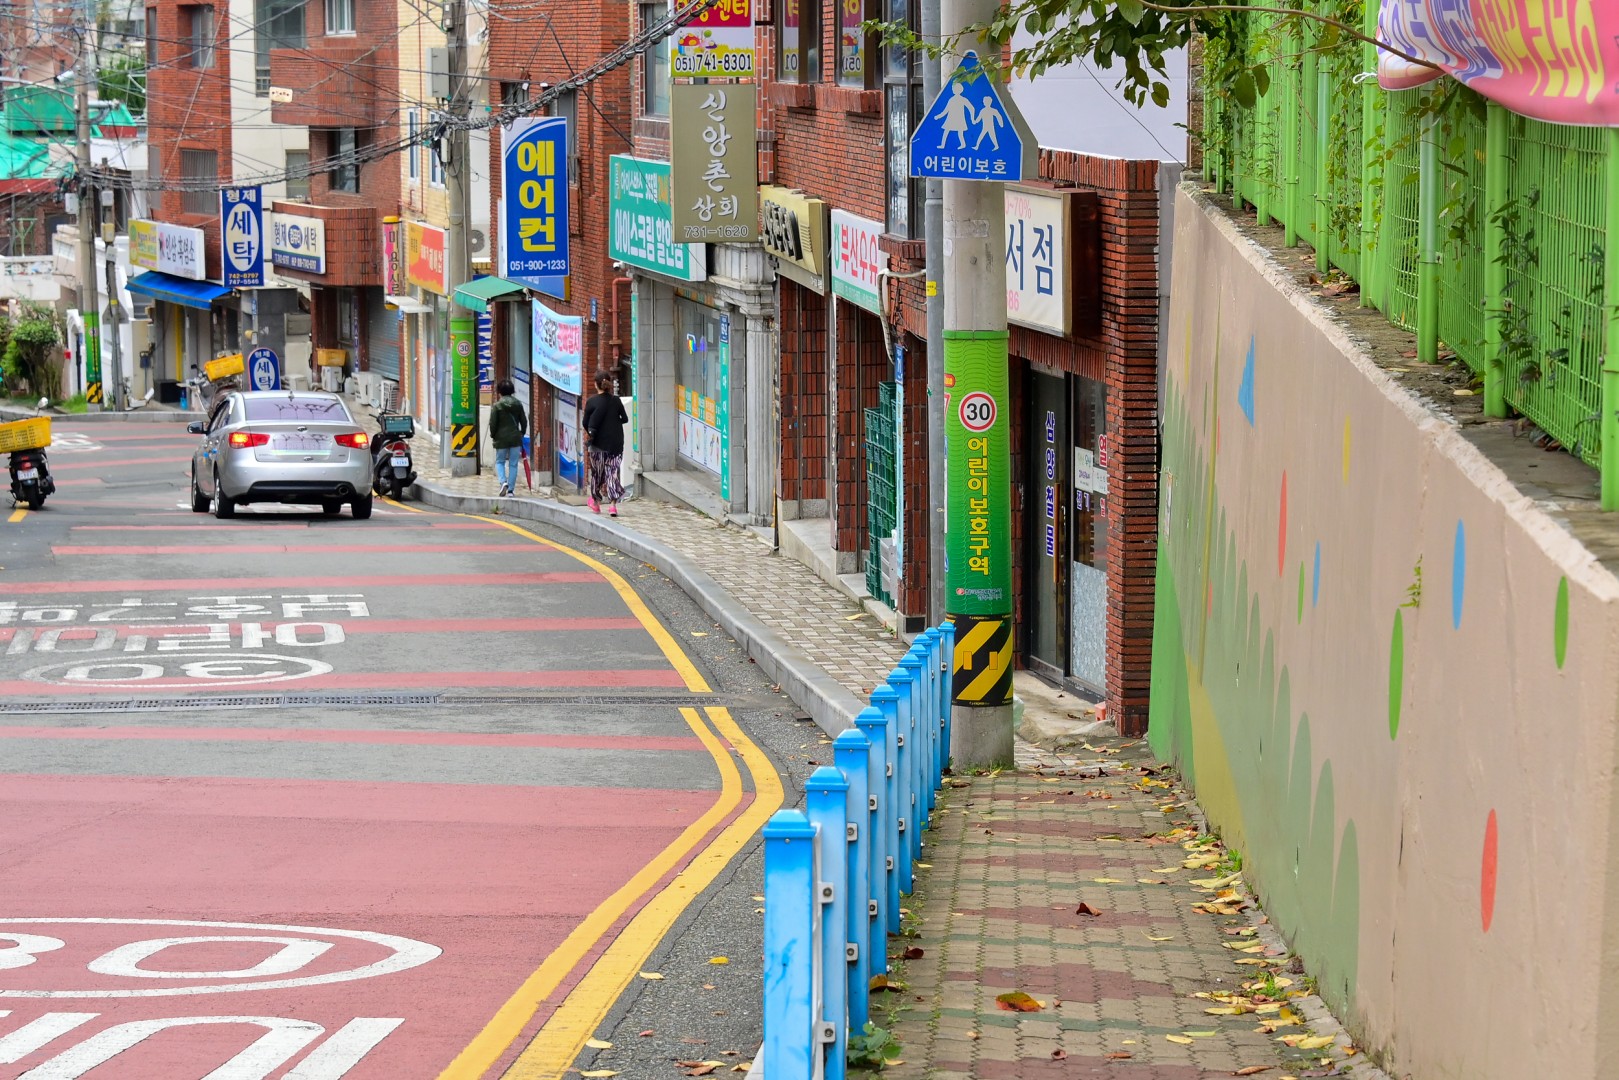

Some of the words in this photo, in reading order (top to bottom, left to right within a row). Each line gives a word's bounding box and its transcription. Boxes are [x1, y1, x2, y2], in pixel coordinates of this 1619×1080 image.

[675, 53, 752, 72] 051)741-8301
[700, 89, 732, 193] 신앙촌
[923, 155, 1008, 176] 어린이보호
[226, 189, 256, 203] 형제
[516, 140, 555, 252] 에어컨
[691, 194, 739, 222] 상회
[231, 210, 255, 266] 세탁
[304, 226, 317, 252] 세탁
[615, 208, 656, 262] 아이스크림
[683, 225, 748, 239] 731-1620
[510, 260, 566, 271] 051-900-1233
[841, 223, 879, 287] 부산우유
[1006, 219, 1053, 296] 서점
[459, 344, 469, 352] 30
[257, 361, 273, 389] 세탁
[966, 403, 991, 421] 30
[968, 437, 989, 575] 어린이보호구역
[63, 659, 287, 682] 30
